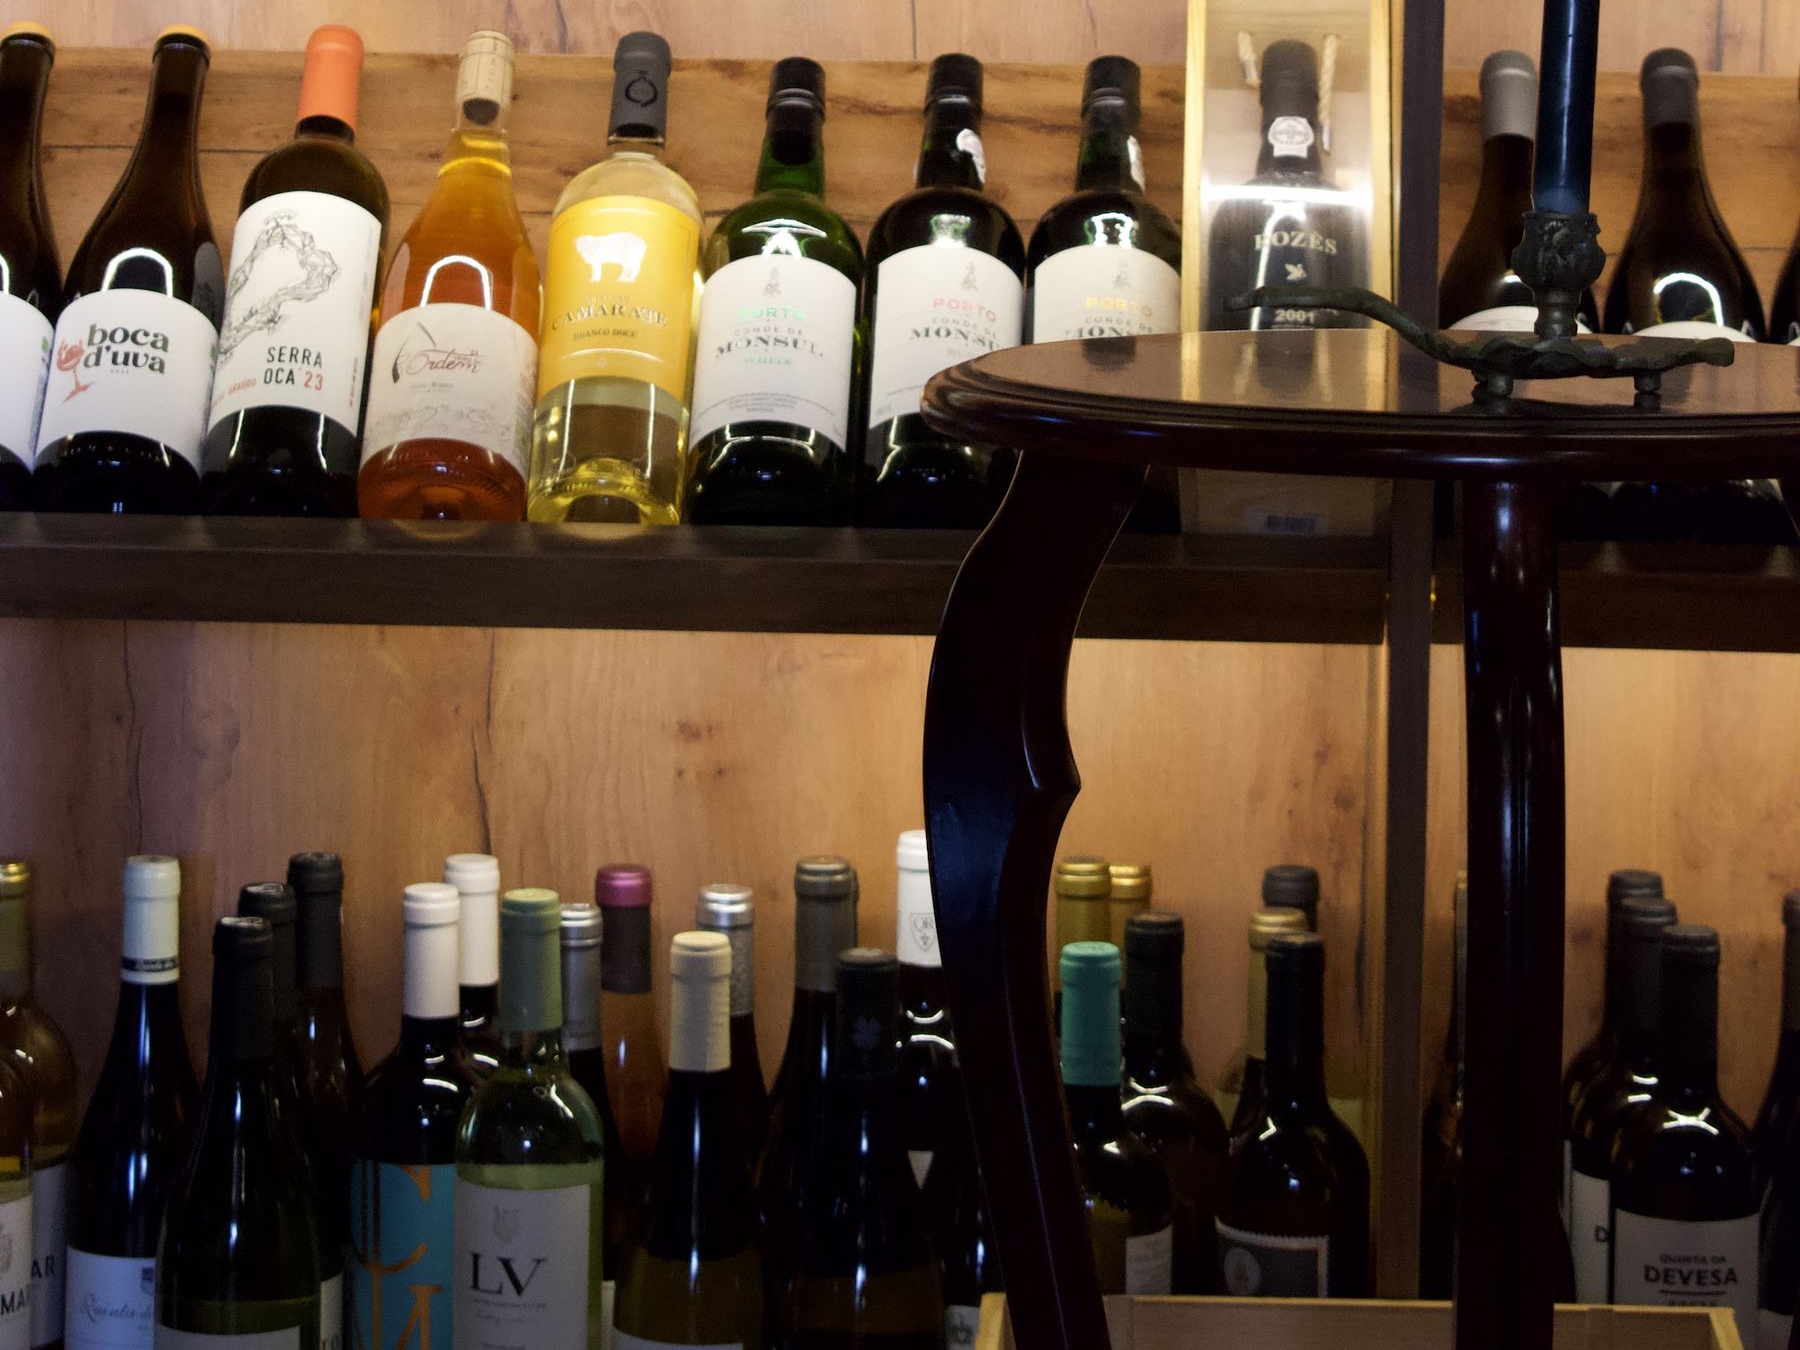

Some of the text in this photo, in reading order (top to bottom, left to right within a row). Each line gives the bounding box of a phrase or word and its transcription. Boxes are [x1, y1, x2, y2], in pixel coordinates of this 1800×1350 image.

[551, 303, 669, 331] CAMARATE
[932, 297, 998, 323] PORTO
[1085, 296, 1153, 318] PORTO
[931, 316, 979, 331] CONDE
[87, 322, 170, 353] boca
[908, 326, 1003, 352] MONSU
[83, 344, 167, 375] d'uva
[266, 345, 324, 369] SERRA
[263, 367, 296, 386] OCA
[470, 1252, 548, 1297] LV
[1643, 1264, 1739, 1287] DEVESA
